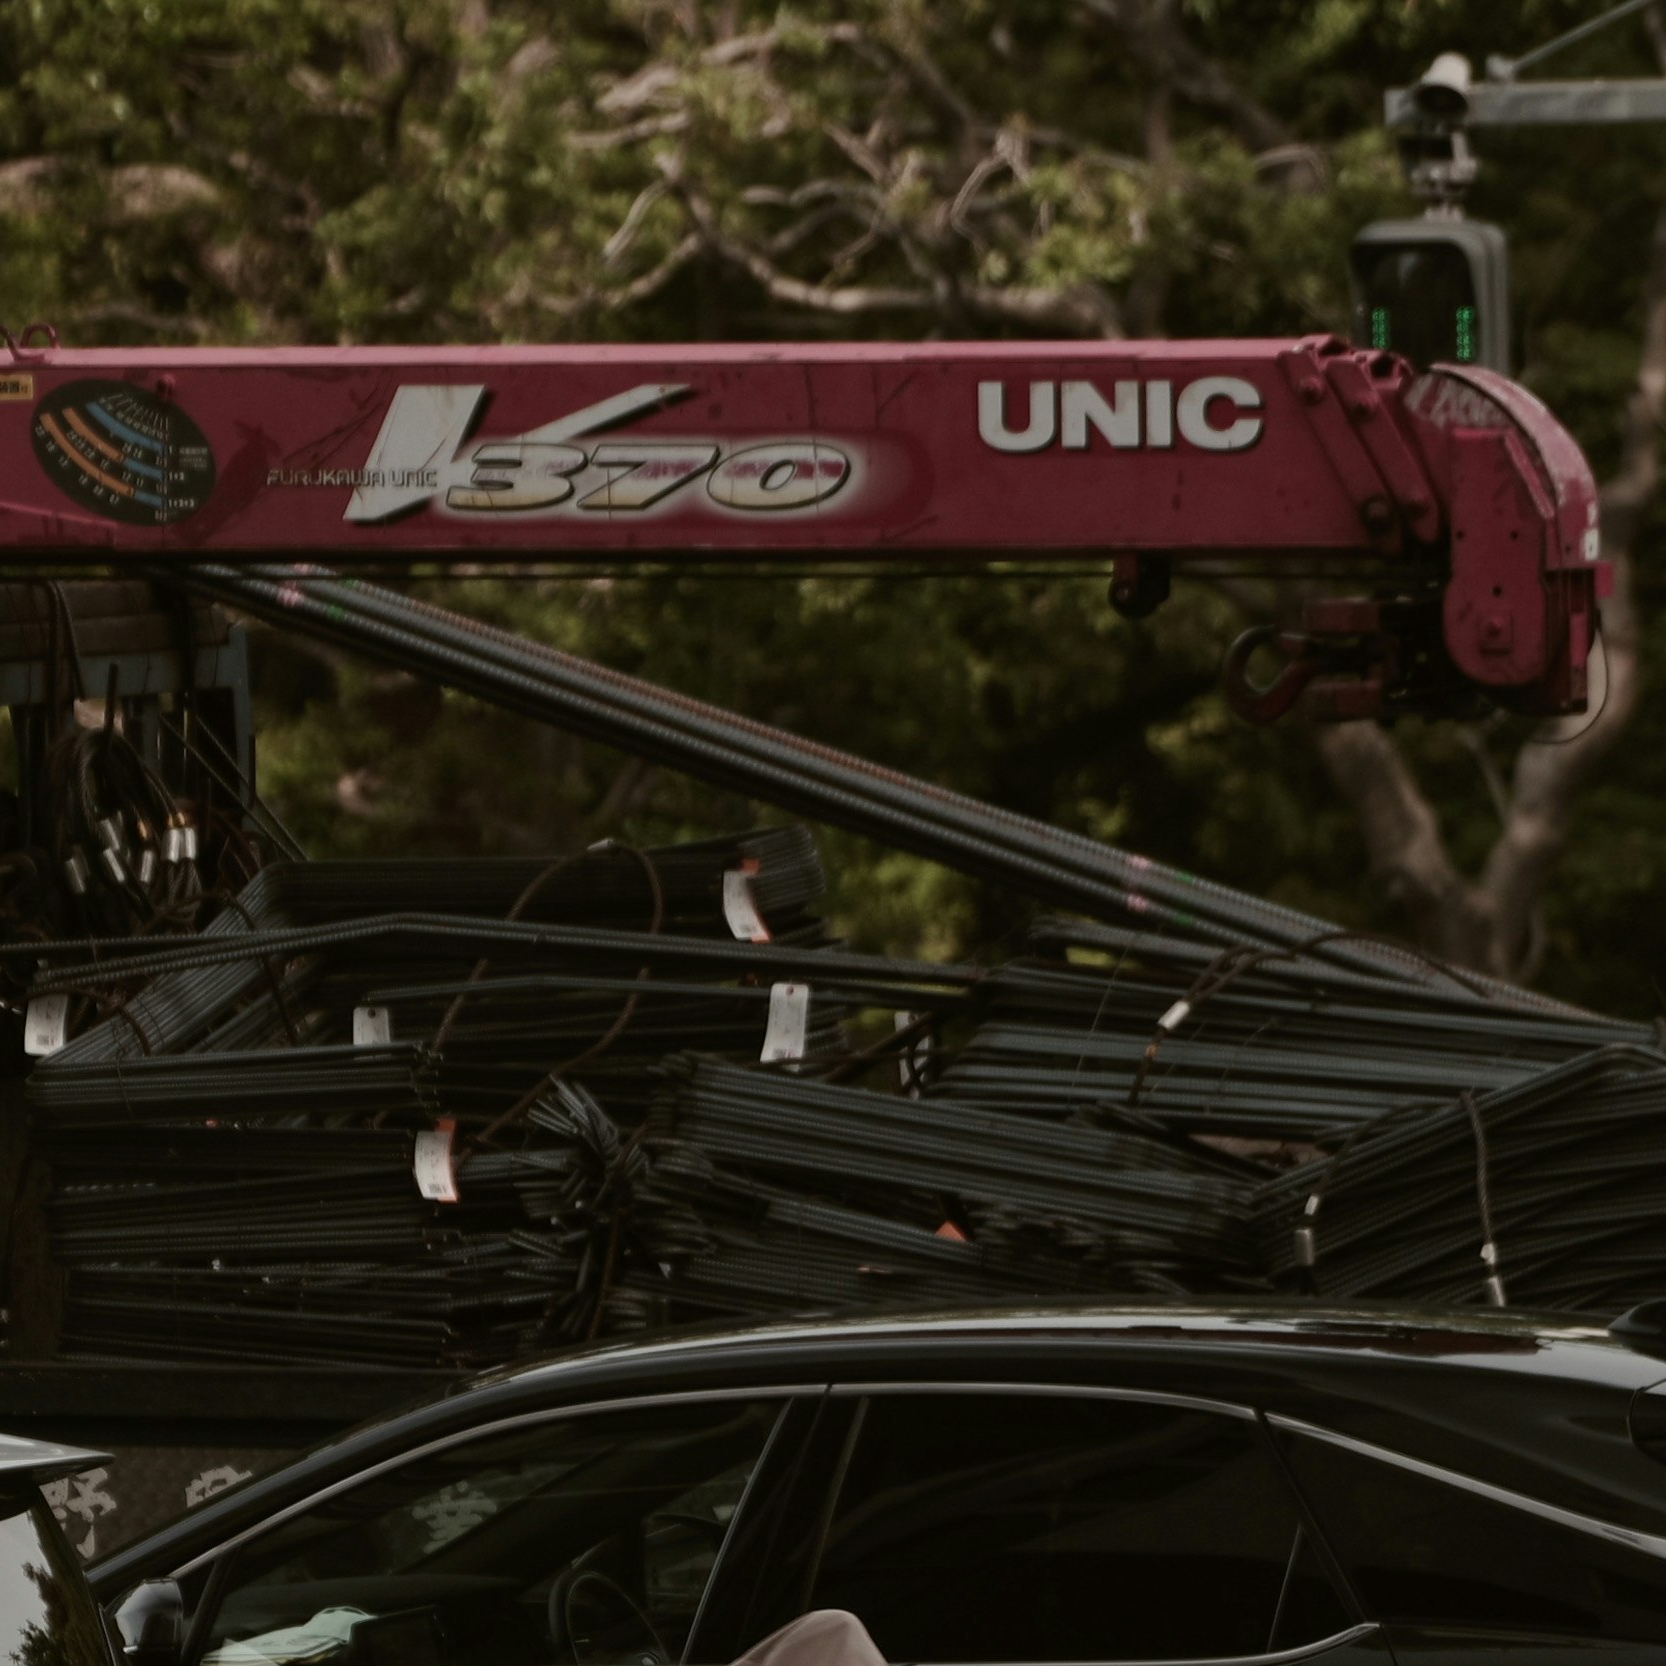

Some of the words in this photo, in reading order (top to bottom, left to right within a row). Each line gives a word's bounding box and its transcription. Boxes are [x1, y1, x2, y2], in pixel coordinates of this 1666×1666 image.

[977, 375, 1264, 454] UNIC
[266, 469, 386, 487] FURUKAWA
[390, 469, 438, 488] UNIC
